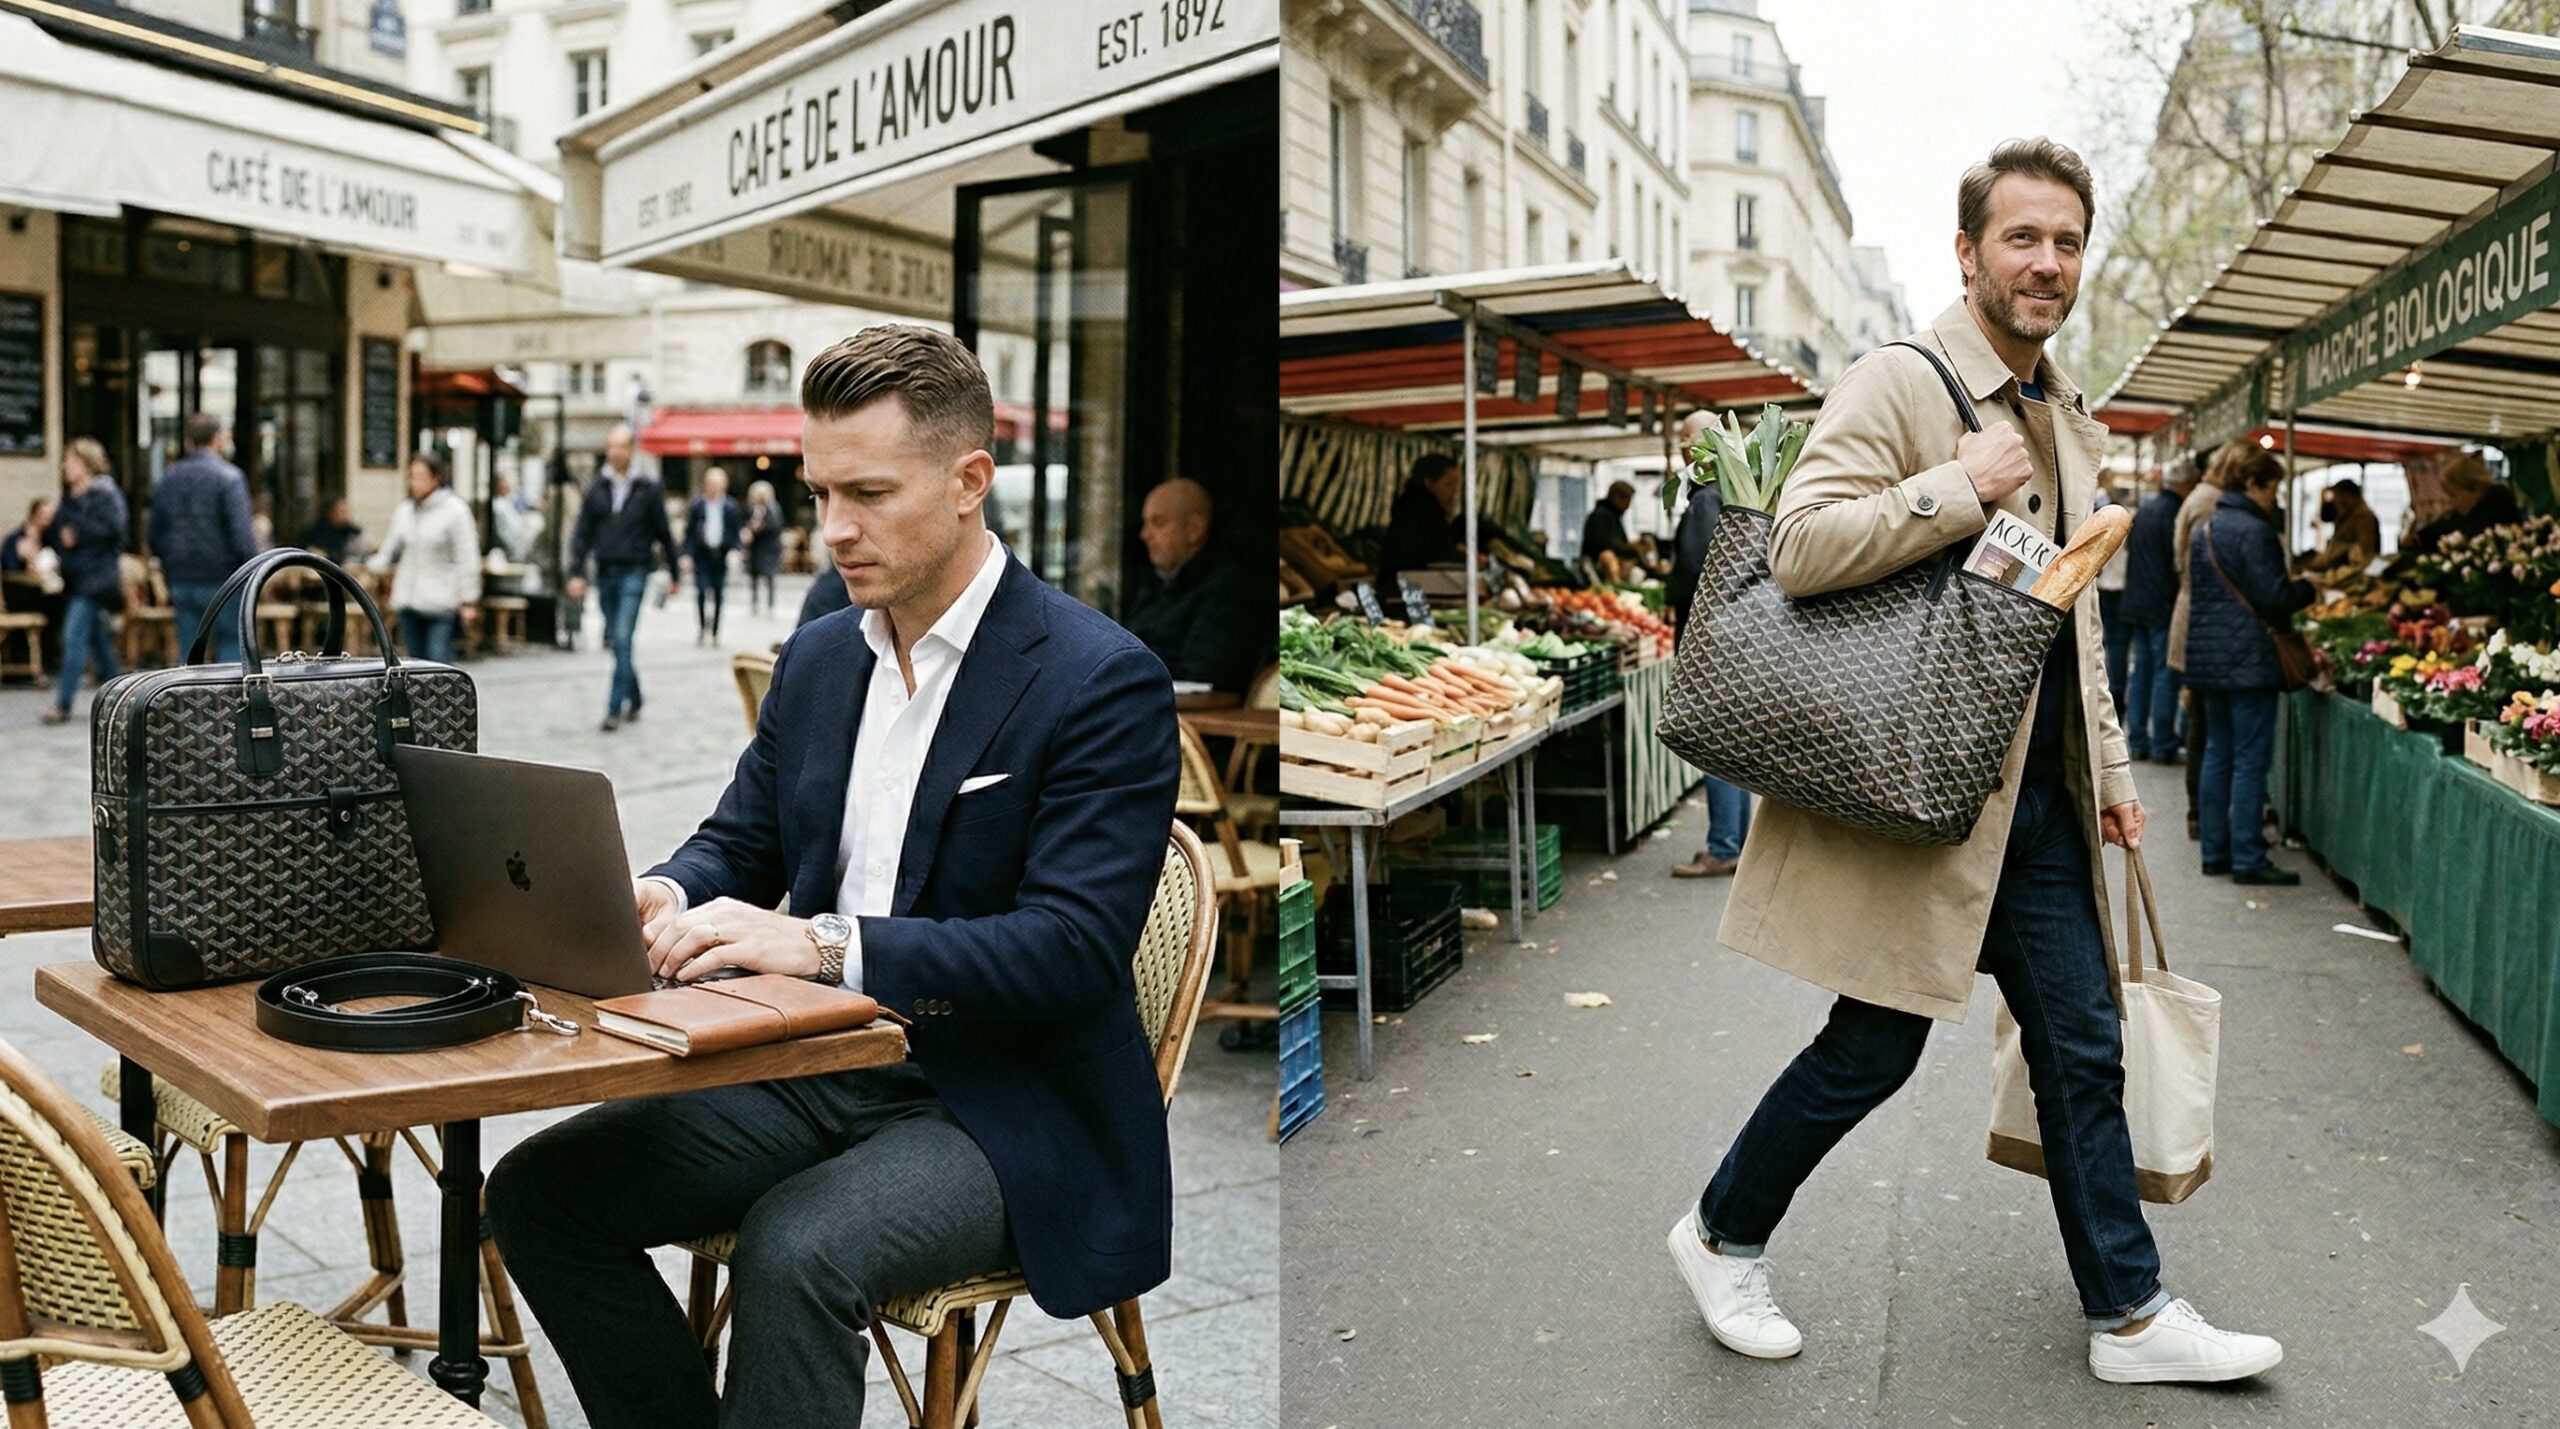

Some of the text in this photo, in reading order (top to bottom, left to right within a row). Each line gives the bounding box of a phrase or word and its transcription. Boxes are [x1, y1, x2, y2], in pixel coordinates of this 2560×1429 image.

[1098, 0, 1225, 70] EST. 1892
[729, 14, 1015, 198] CAFÉ DE L'AMOUR
[205, 149, 270, 205] CAFÉ
[280, 166, 310, 212] DE
[2306, 210, 2551, 391] MARCHÉ BIOLOGIQUE
